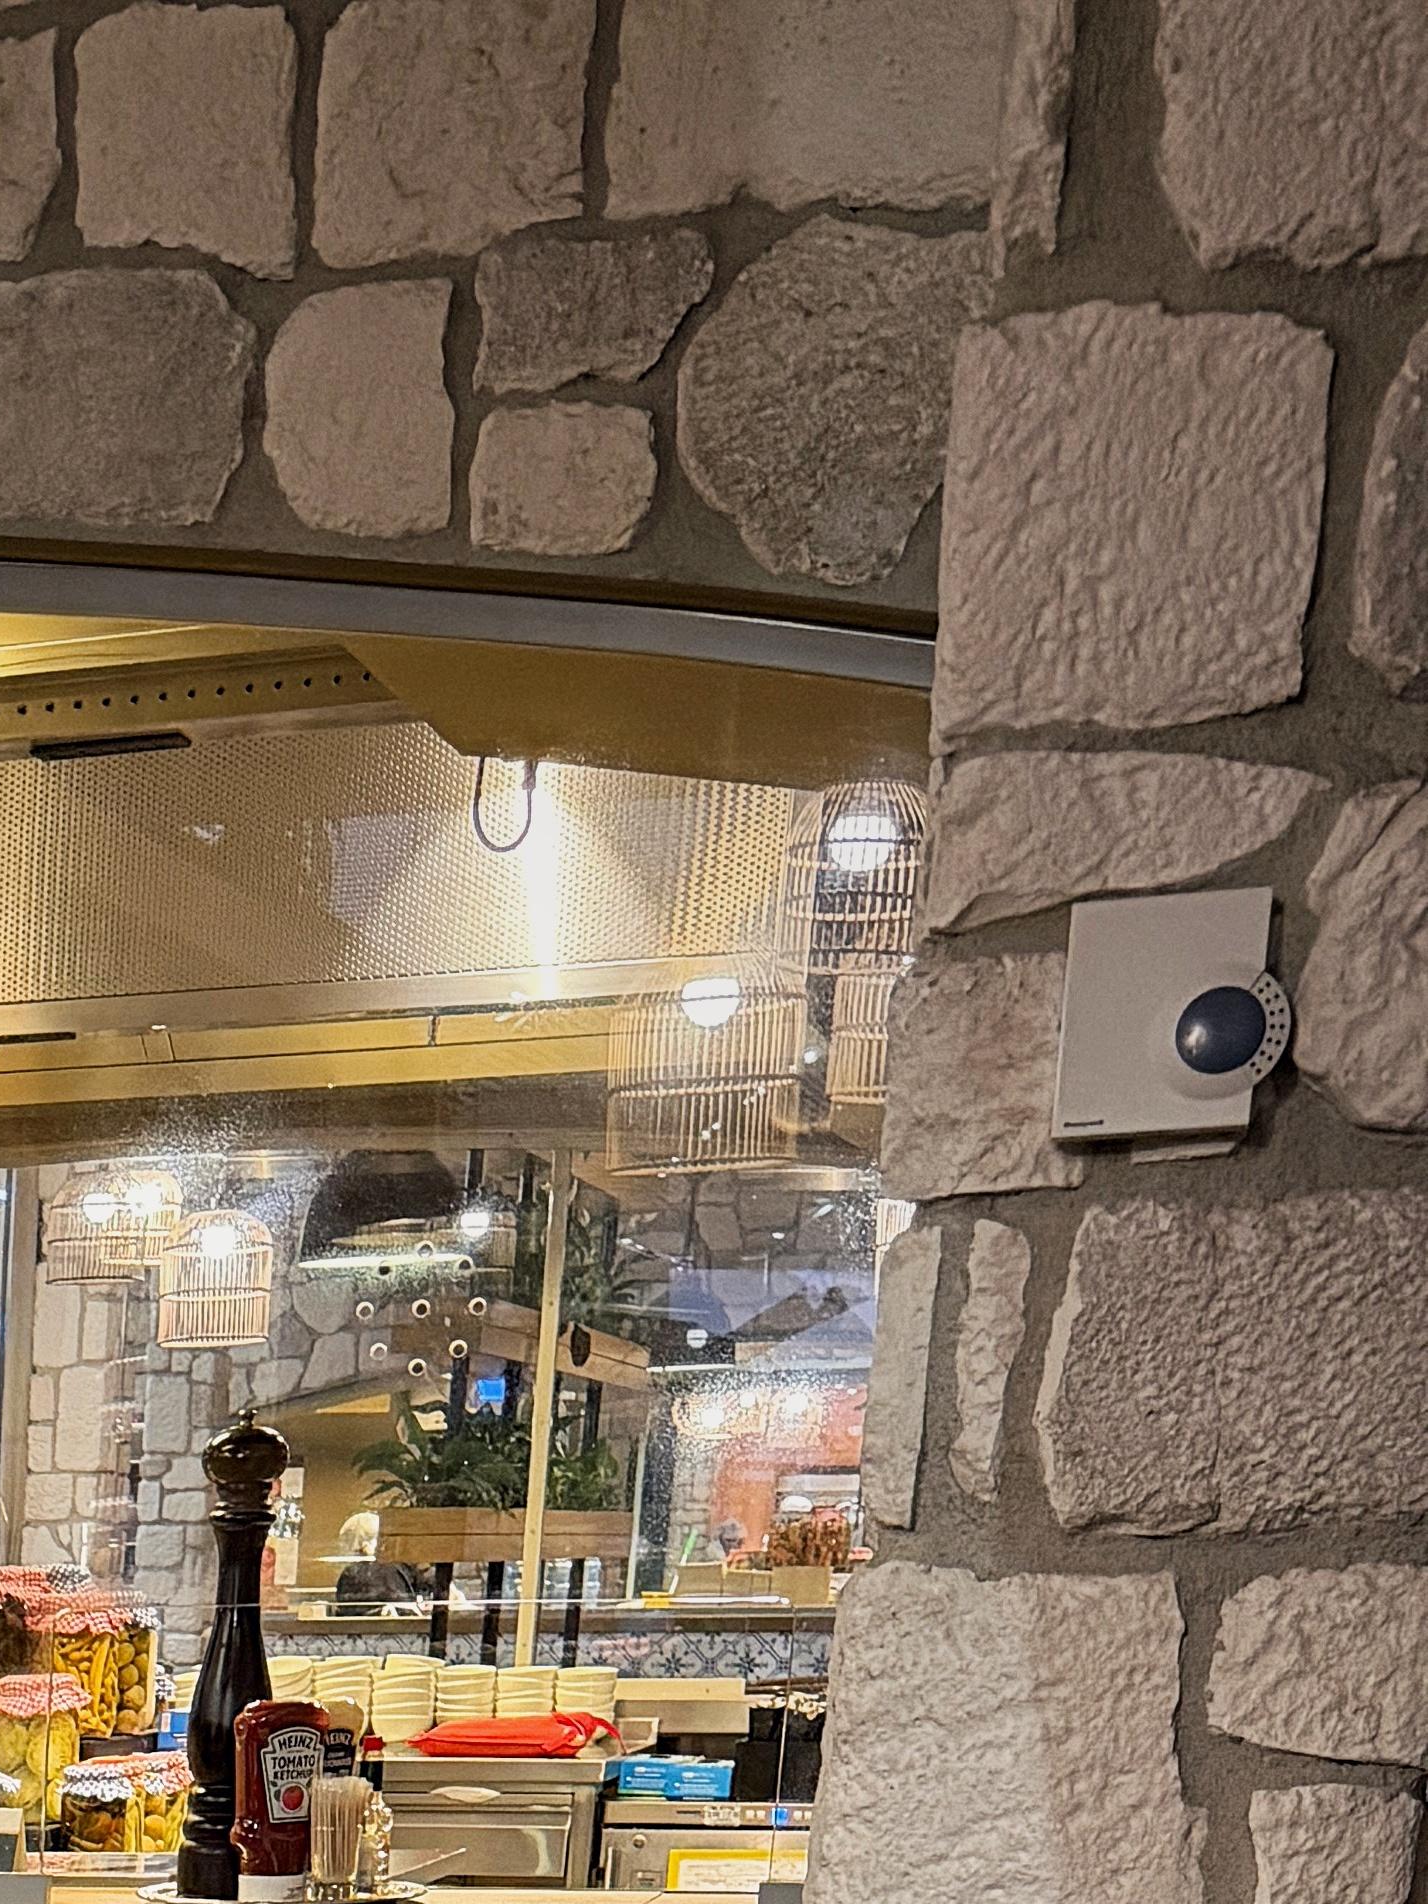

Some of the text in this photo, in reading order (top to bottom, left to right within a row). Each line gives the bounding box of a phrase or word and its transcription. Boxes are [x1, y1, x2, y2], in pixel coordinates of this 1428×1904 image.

[278, 1734, 315, 1750] HEINZ
[271, 1754, 316, 1770] TOMATO
[273, 1769, 314, 1781] KETCHUP
